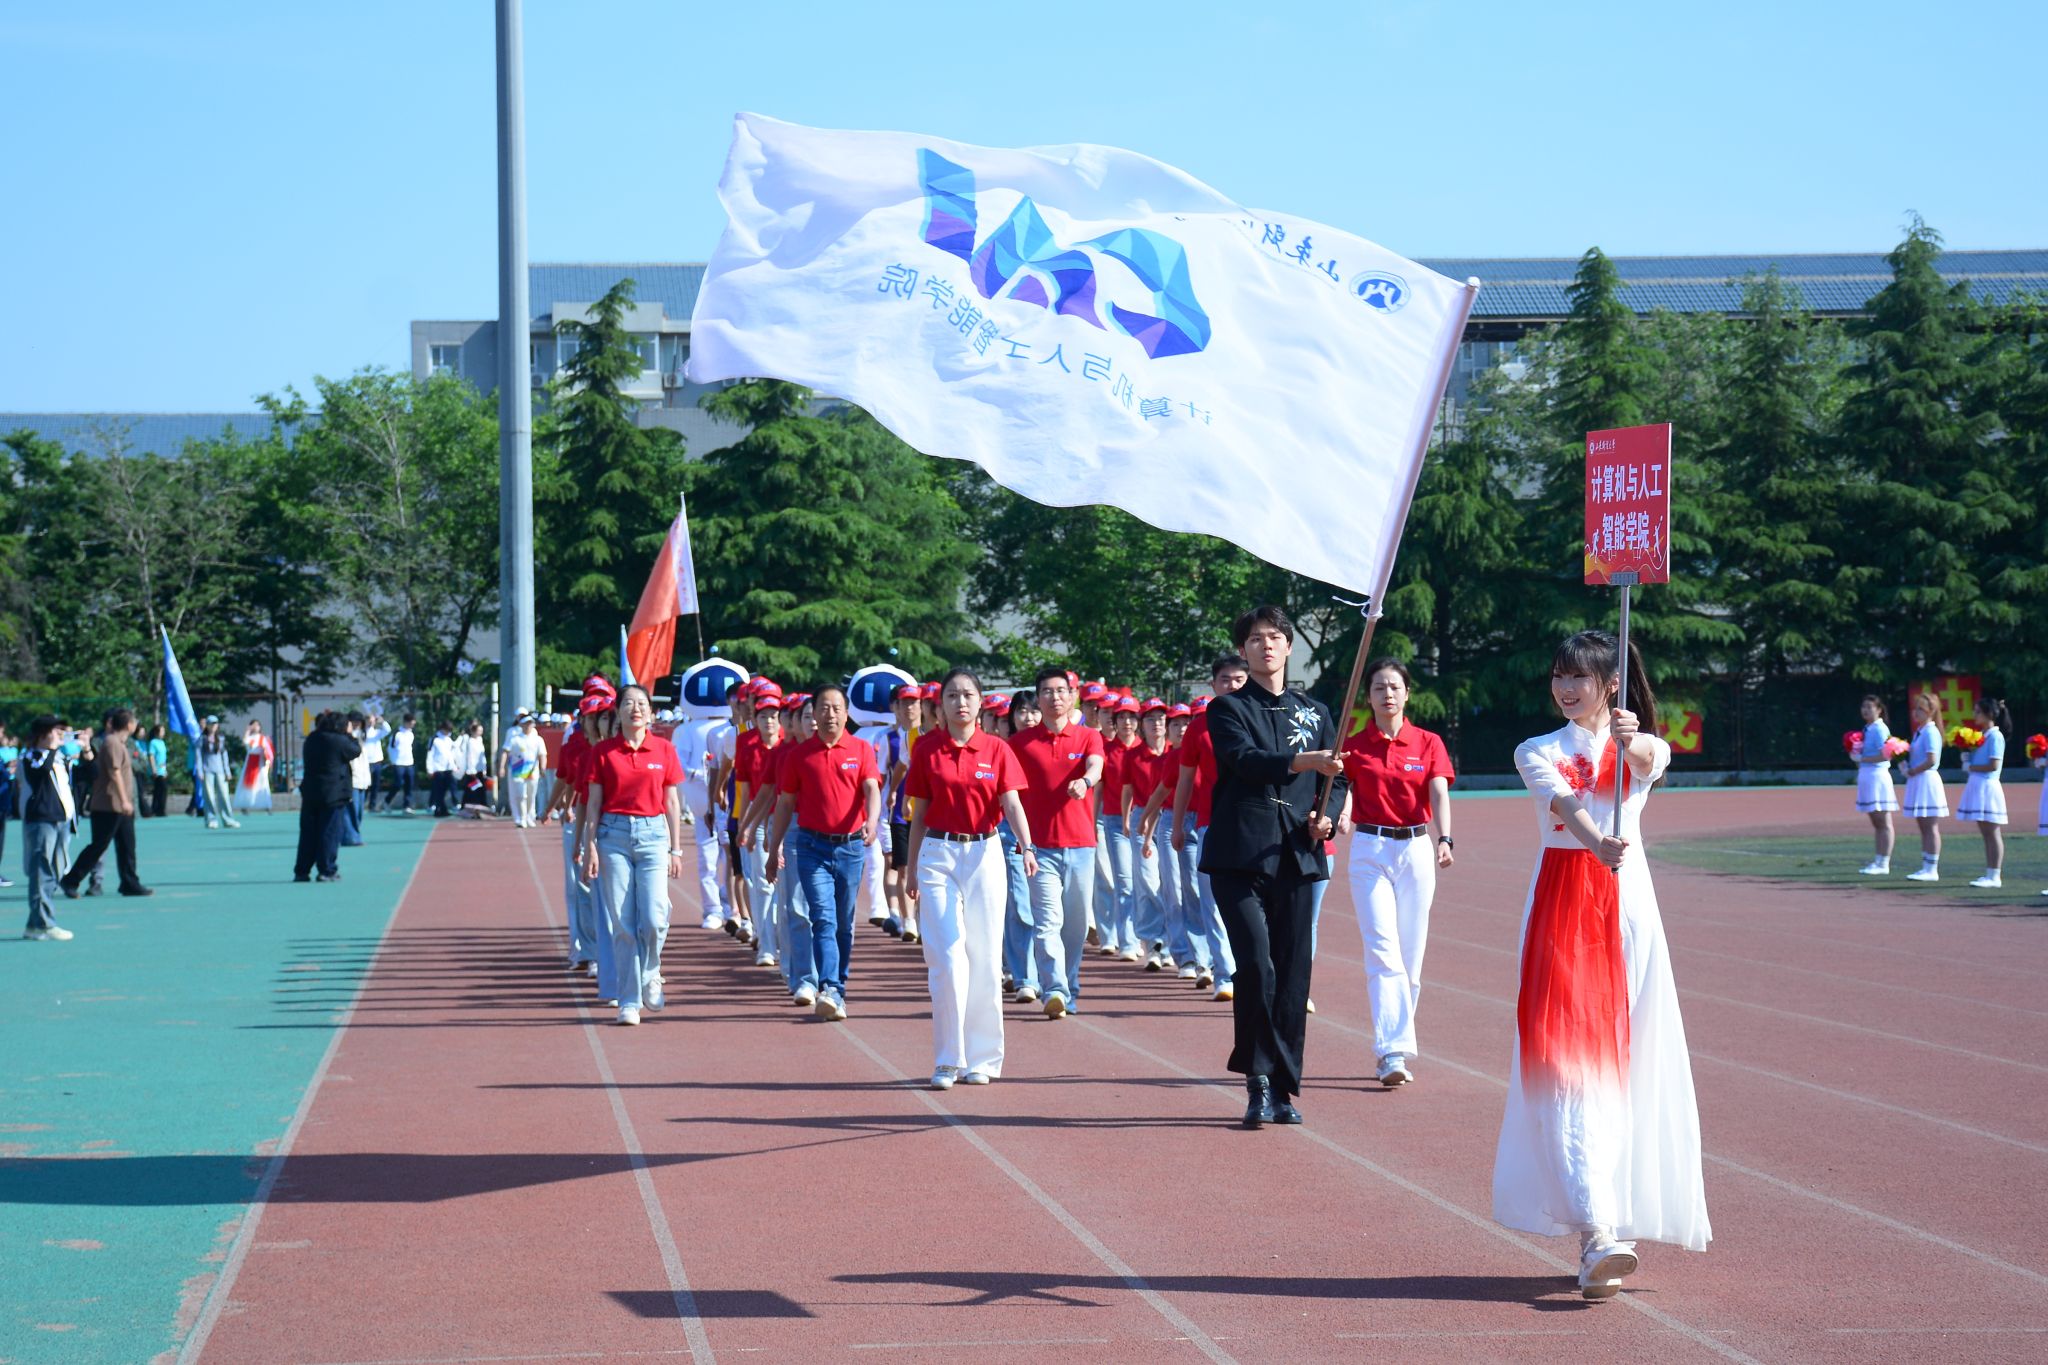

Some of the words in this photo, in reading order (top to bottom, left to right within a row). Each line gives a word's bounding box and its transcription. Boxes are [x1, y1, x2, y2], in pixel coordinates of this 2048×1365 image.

[1591, 463, 1663, 505] 计算机与人工
[1602, 510, 1650, 553] 智能学院
